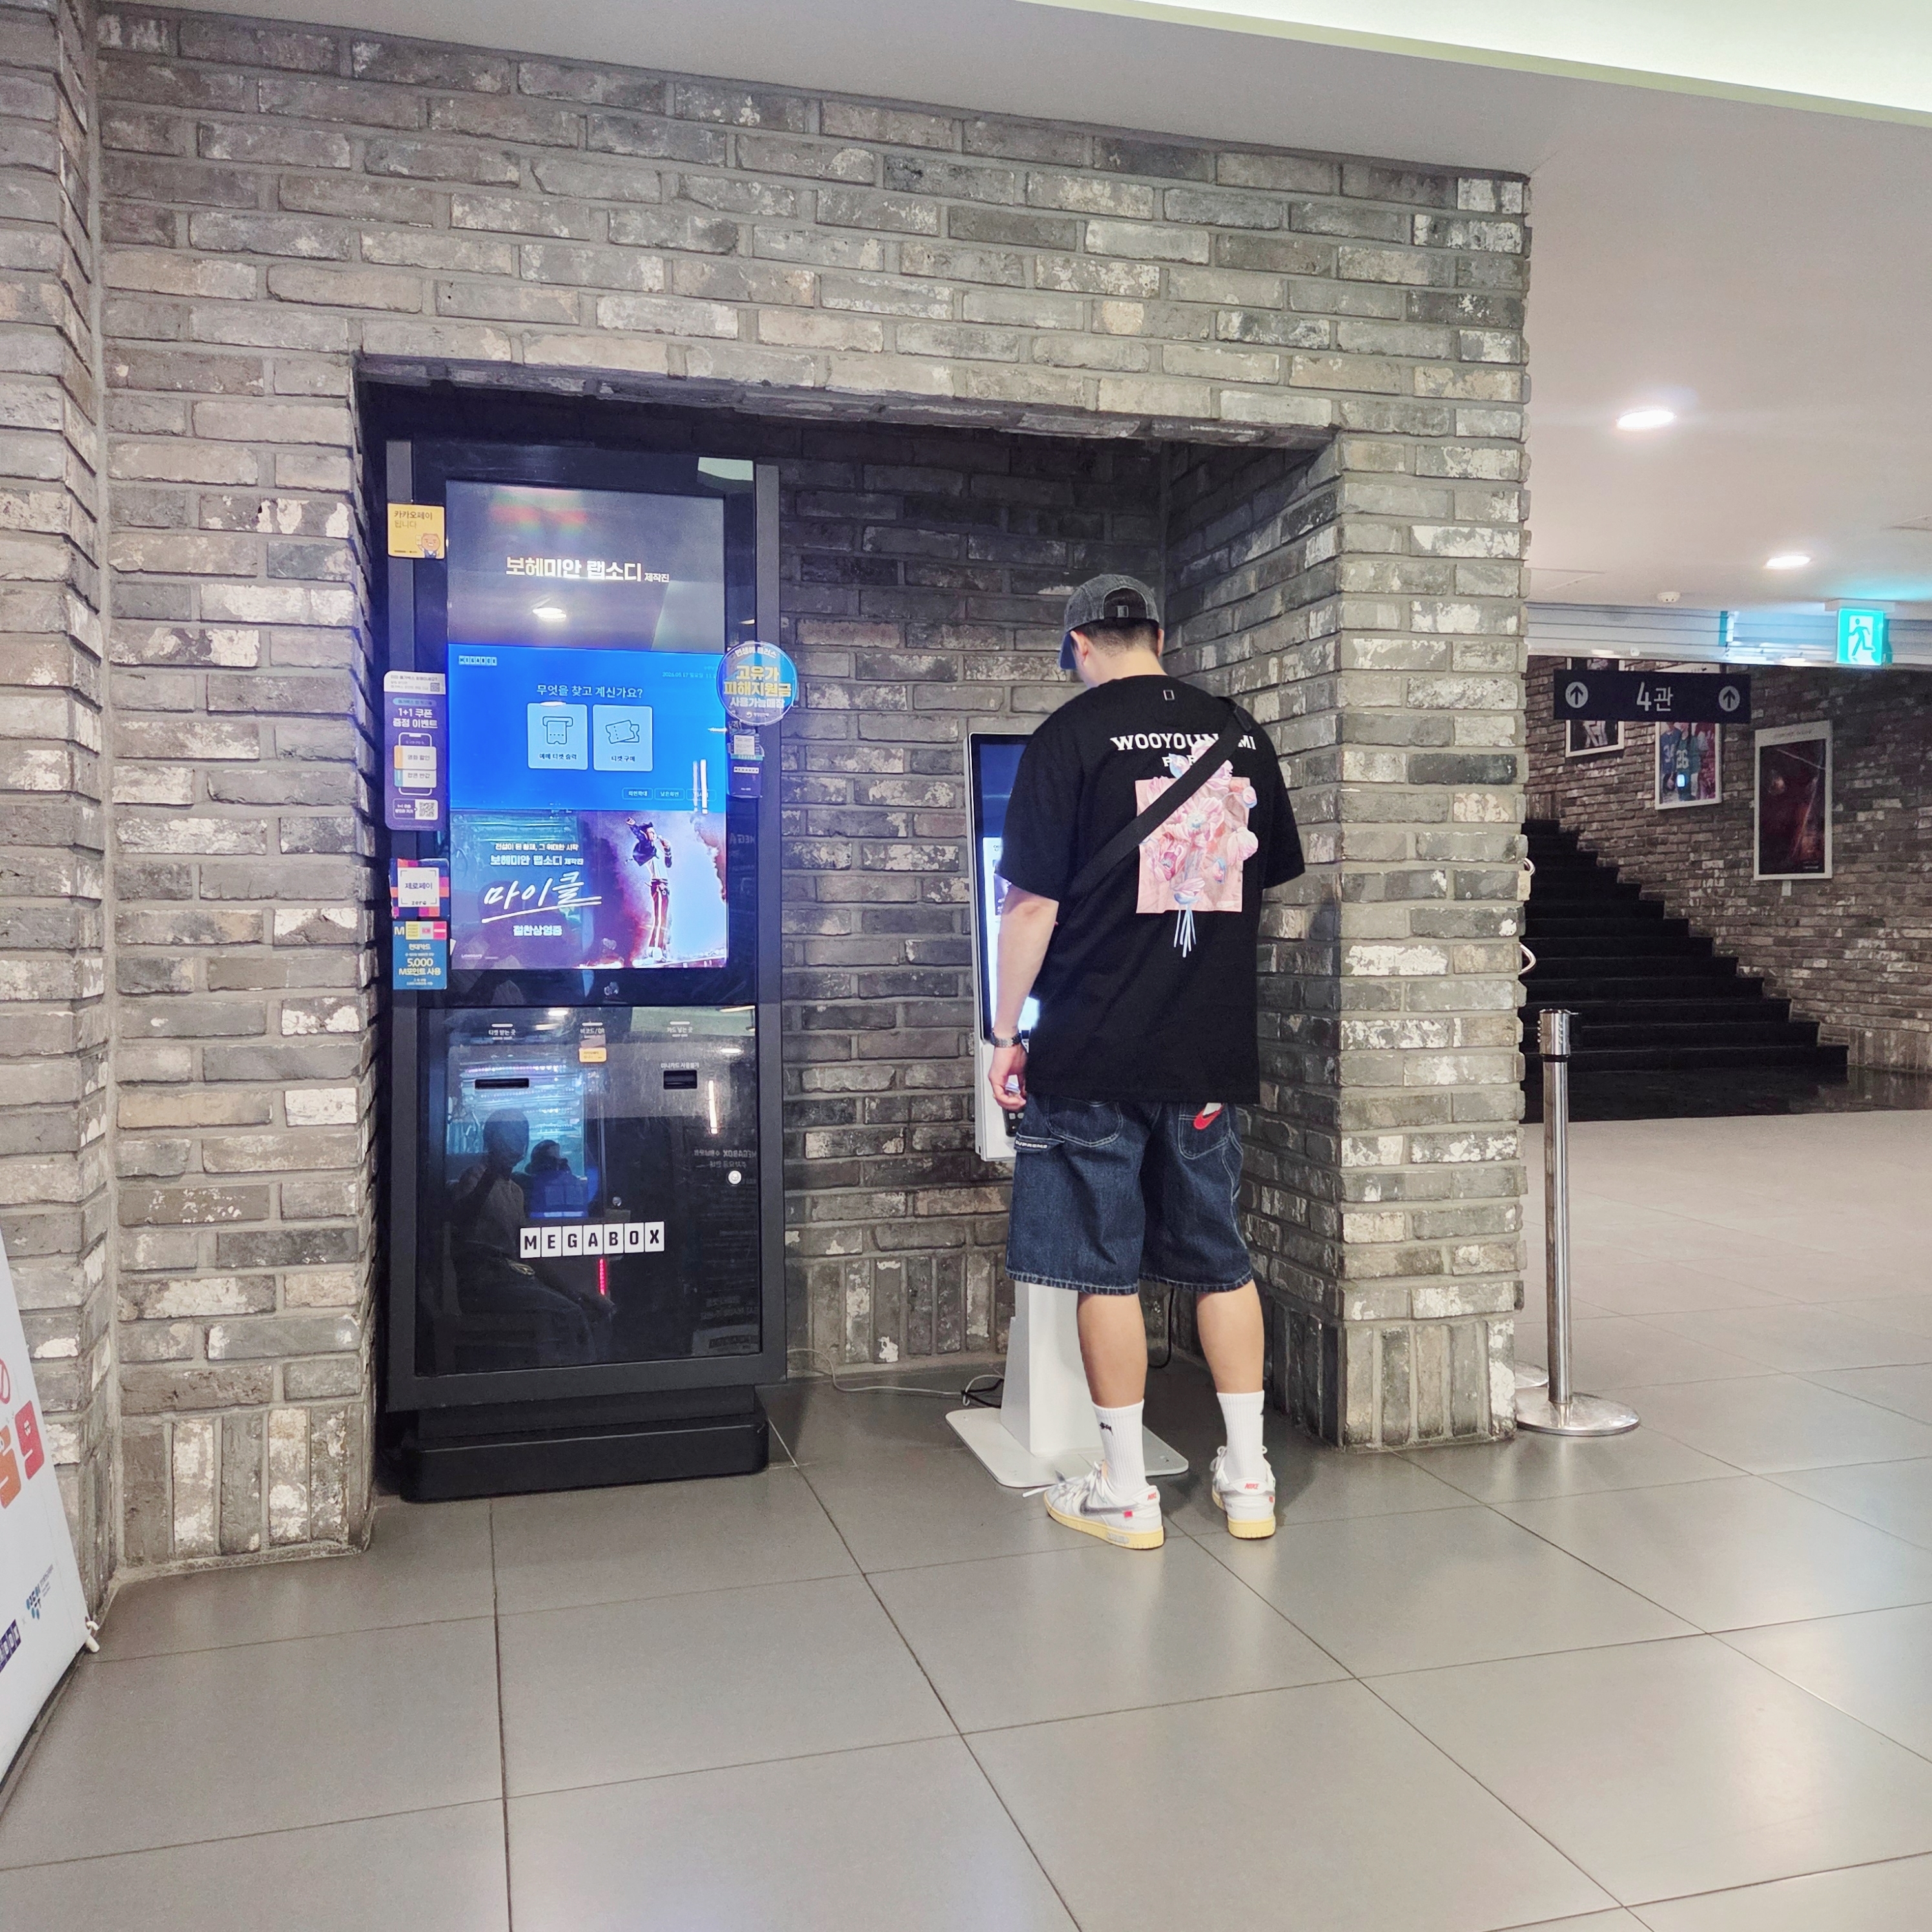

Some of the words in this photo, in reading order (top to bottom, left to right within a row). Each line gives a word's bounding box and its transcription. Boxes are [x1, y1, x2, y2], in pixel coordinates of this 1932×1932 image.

[394, 510, 433, 520] 카카오페이
[395, 520, 417, 529] 됩니다
[506, 557, 582, 577] 보헤미안
[586, 560, 642, 581] 랩소디
[644, 572, 670, 582] 제작진
[736, 665, 779, 681] 고유가
[537, 684, 569, 697] 무엇을
[572, 685, 592, 697] 찾고
[595, 686, 643, 699] 계신가요?
[724, 681, 792, 697] 피해지원금
[1636, 681, 1674, 712] 4관
[730, 697, 785, 708] 사용가능매장
[398, 708, 413, 717] 1+1
[415, 708, 433, 718] 쿠폰
[413, 719, 438, 729] 이벤트
[490, 854, 531, 866] 보헤미안
[533, 855, 562, 866] 랩소디
[564, 858, 584, 866] 제작진
[484, 871, 602, 910] 마이클
[394, 926, 406, 936] M
[513, 925, 563, 937] 절찬상영중
[407, 958, 434, 967] 5,000
[427, 967, 441, 976] 사용
[524, 1229, 660, 1250] MEGABOX
[1147, 1492, 1157, 1501] NIKE
